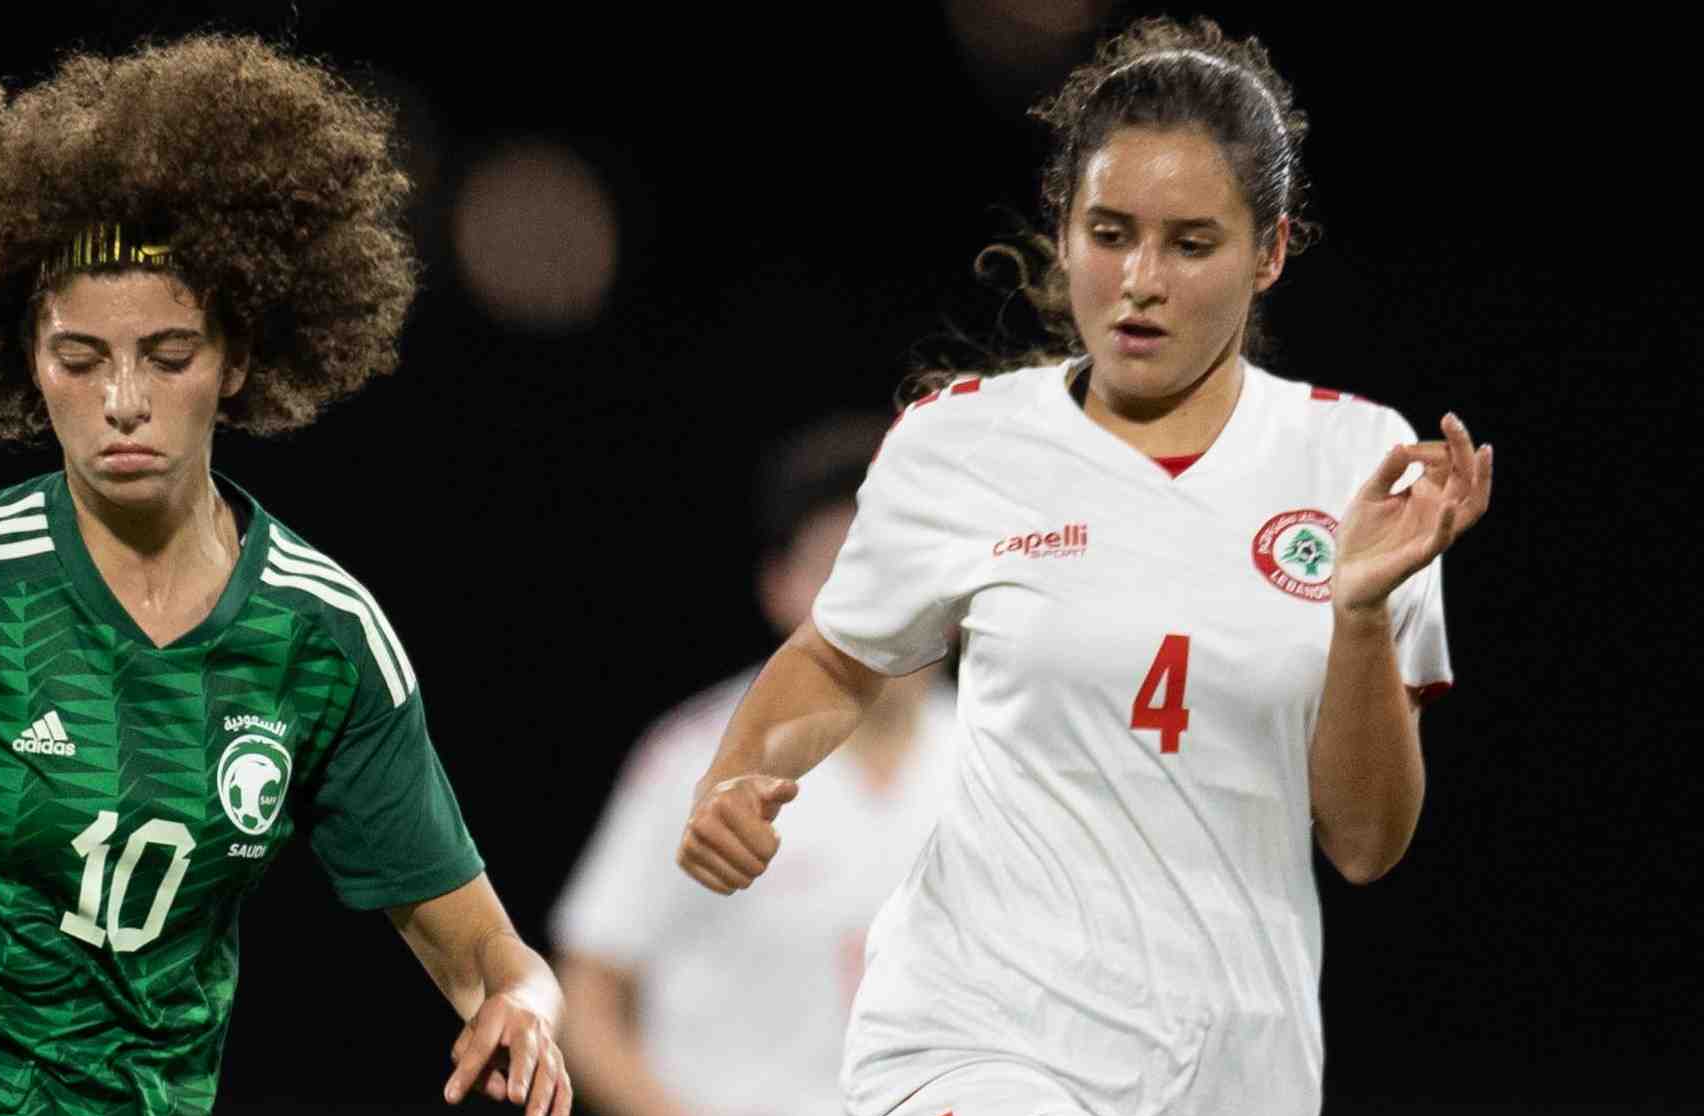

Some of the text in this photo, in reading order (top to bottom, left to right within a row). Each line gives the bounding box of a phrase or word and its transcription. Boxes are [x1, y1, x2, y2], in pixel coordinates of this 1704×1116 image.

[992, 522, 1089, 557] capelli
[1130, 634, 1191, 754] 4
[223, 715, 287, 737] السعودية
[12, 738, 76, 757] adidas
[227, 843, 267, 859] SAUDI
[60, 810, 198, 953] 10
